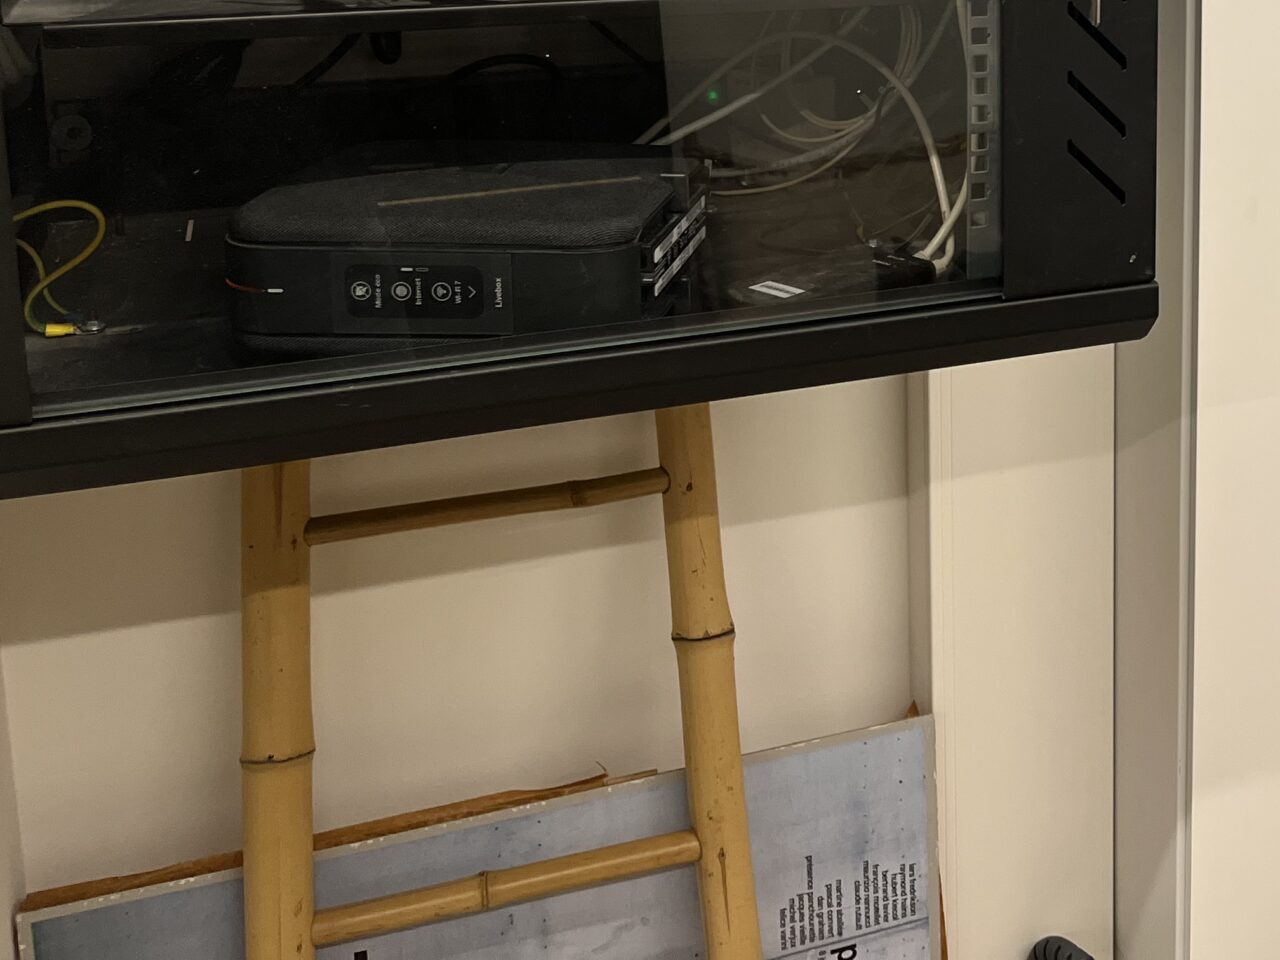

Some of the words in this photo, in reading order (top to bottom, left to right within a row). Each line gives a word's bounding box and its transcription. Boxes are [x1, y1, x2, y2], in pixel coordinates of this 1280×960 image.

[374, 288, 382, 308] Mode
[495, 277, 504, 308] Livebox
[871, 864, 880, 894] françois
[898, 863, 908, 897] raymond
[908, 862, 916, 878] lars
[824, 883, 834, 908] pascal
[854, 880, 862, 906] claude
[882, 870, 890, 902] bertrand
[780, 908, 788, 928] felice
[788, 898, 797, 924] michel
[796, 893, 805, 922] jacques
[816, 912, 825, 942] graham
